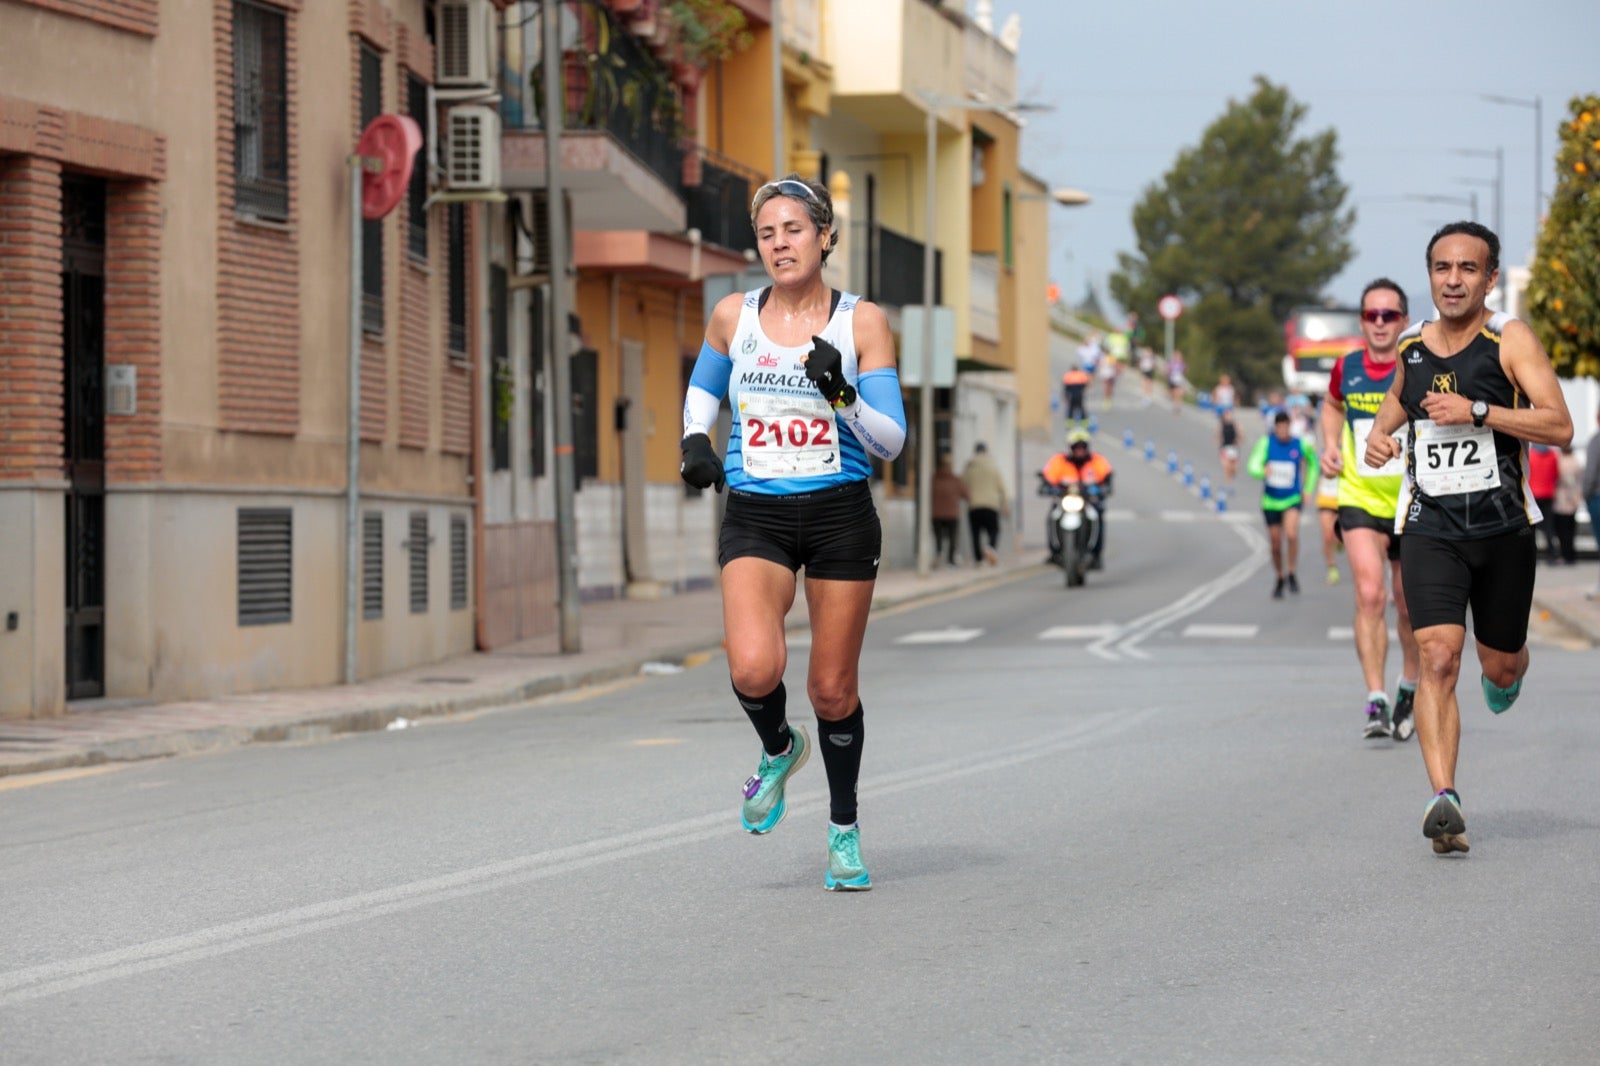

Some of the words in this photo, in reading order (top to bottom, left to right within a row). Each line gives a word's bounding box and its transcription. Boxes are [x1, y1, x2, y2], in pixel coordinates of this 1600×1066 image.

[740, 371, 818, 389] MARACEN
[779, 388, 818, 398] ATLETISMO
[747, 418, 832, 447] 2102
[1427, 440, 1481, 469] 572
[1408, 496, 1422, 522] VEN
